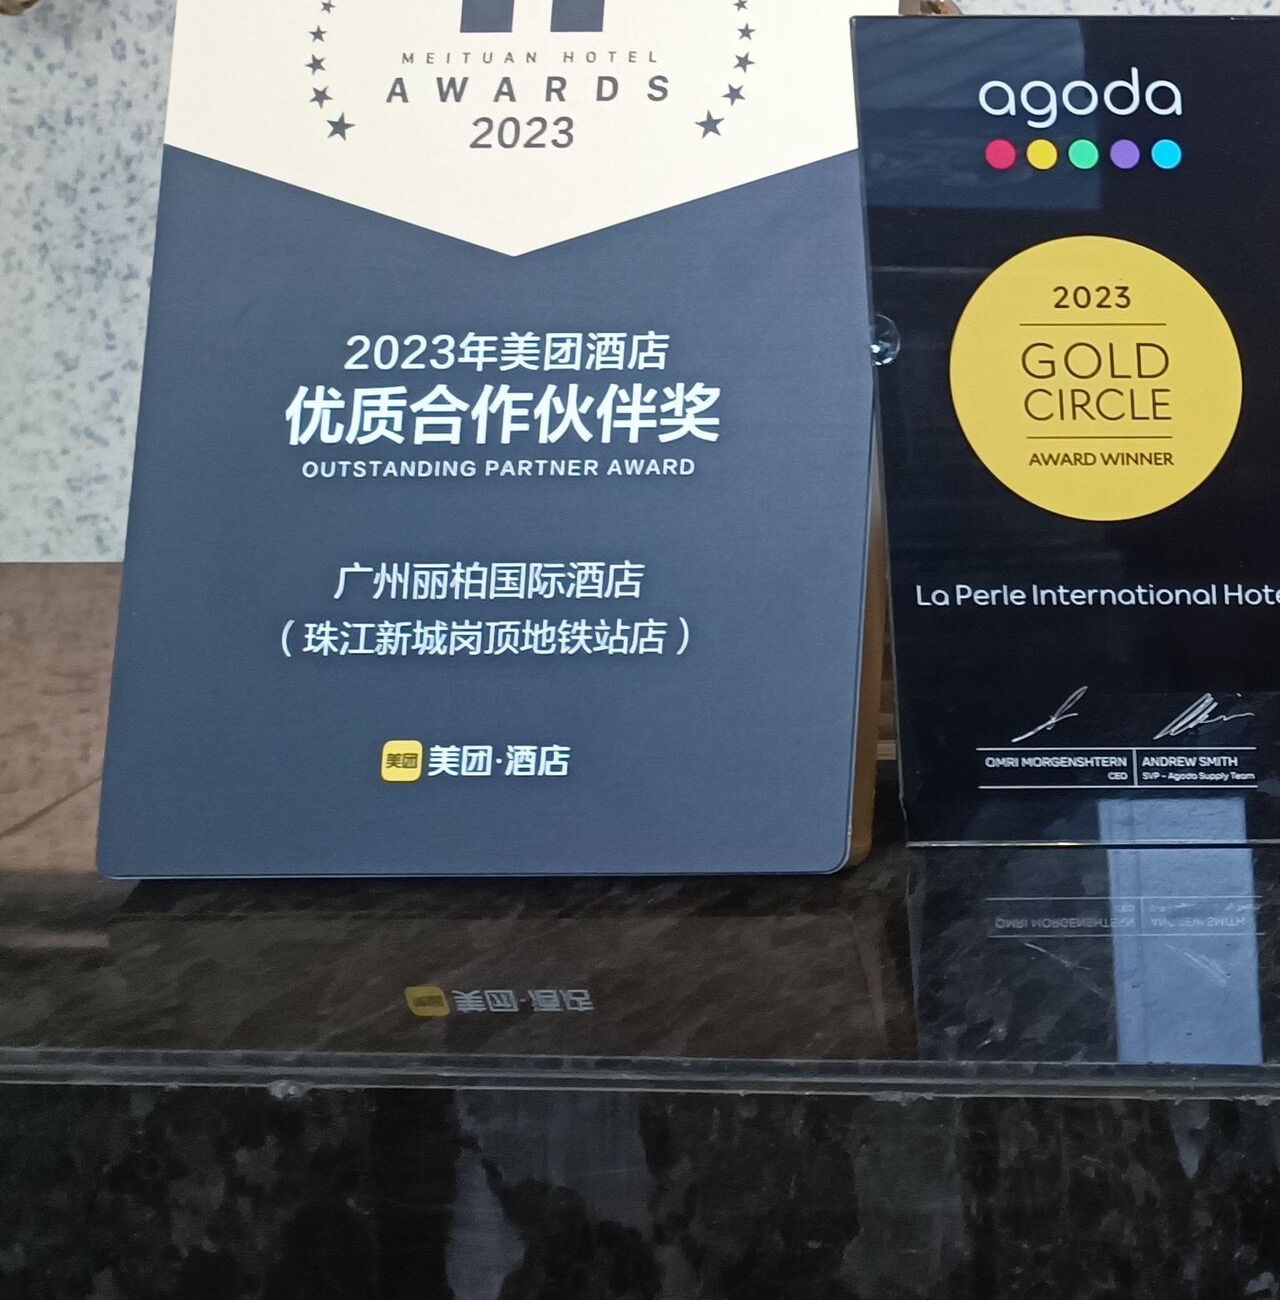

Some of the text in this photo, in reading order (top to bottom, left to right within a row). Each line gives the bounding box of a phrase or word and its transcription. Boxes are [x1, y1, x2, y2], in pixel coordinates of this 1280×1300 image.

[401, 50, 660, 65] MEITUAN HOTEL
[385, 75, 671, 104] AWARDS
[978, 67, 1184, 128] agoda
[469, 116, 576, 150] 2023
[1052, 285, 1132, 310] 2023
[343, 330, 671, 373] 2023年美团酒店
[1020, 342, 1171, 381] GOLD
[283, 383, 721, 447] 优质合作伙伴奖
[1023, 388, 1173, 423] CIRCLE
[301, 458, 696, 478] OUTSTANDING PARTNER AWARD
[1028, 450, 1176, 467] AWARD WINNER
[332, 560, 646, 602] 广州丽柏国际酒店
[915, 583, 951, 607] La
[954, 583, 1027, 607] Perle
[1031, 583, 1218, 607] International
[280, 616, 692, 658] （珠江新城岗顶地铁站店）
[386, 753, 419, 770] 美团
[427, 744, 572, 777] 美团·酒店
[985, 756, 1128, 768] OMRI MORGENSHTERN
[1141, 756, 1239, 768] ANDREW SMITH
[1107, 772, 1128, 781] CEO
[1168, 772, 1198, 782] Agoda
[1199, 772, 1230, 782] Supply
[1231, 772, 1256, 781] Team
